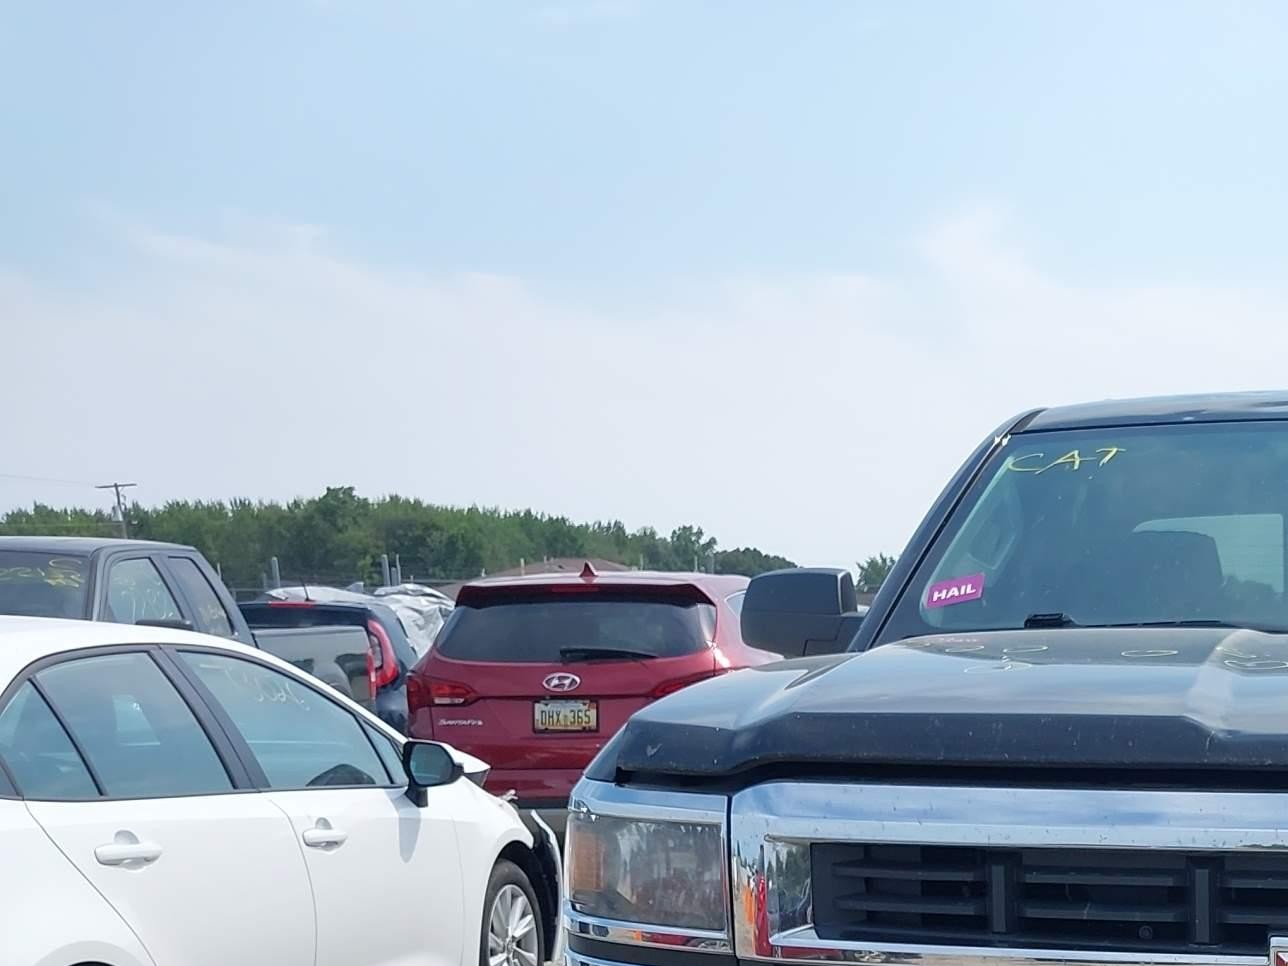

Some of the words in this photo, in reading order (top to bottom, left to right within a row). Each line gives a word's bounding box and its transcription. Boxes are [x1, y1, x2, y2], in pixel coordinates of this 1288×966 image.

[1008, 447, 1127, 475] CAT
[932, 583, 977, 602] HAIL
[569, 709, 591, 725] 365
